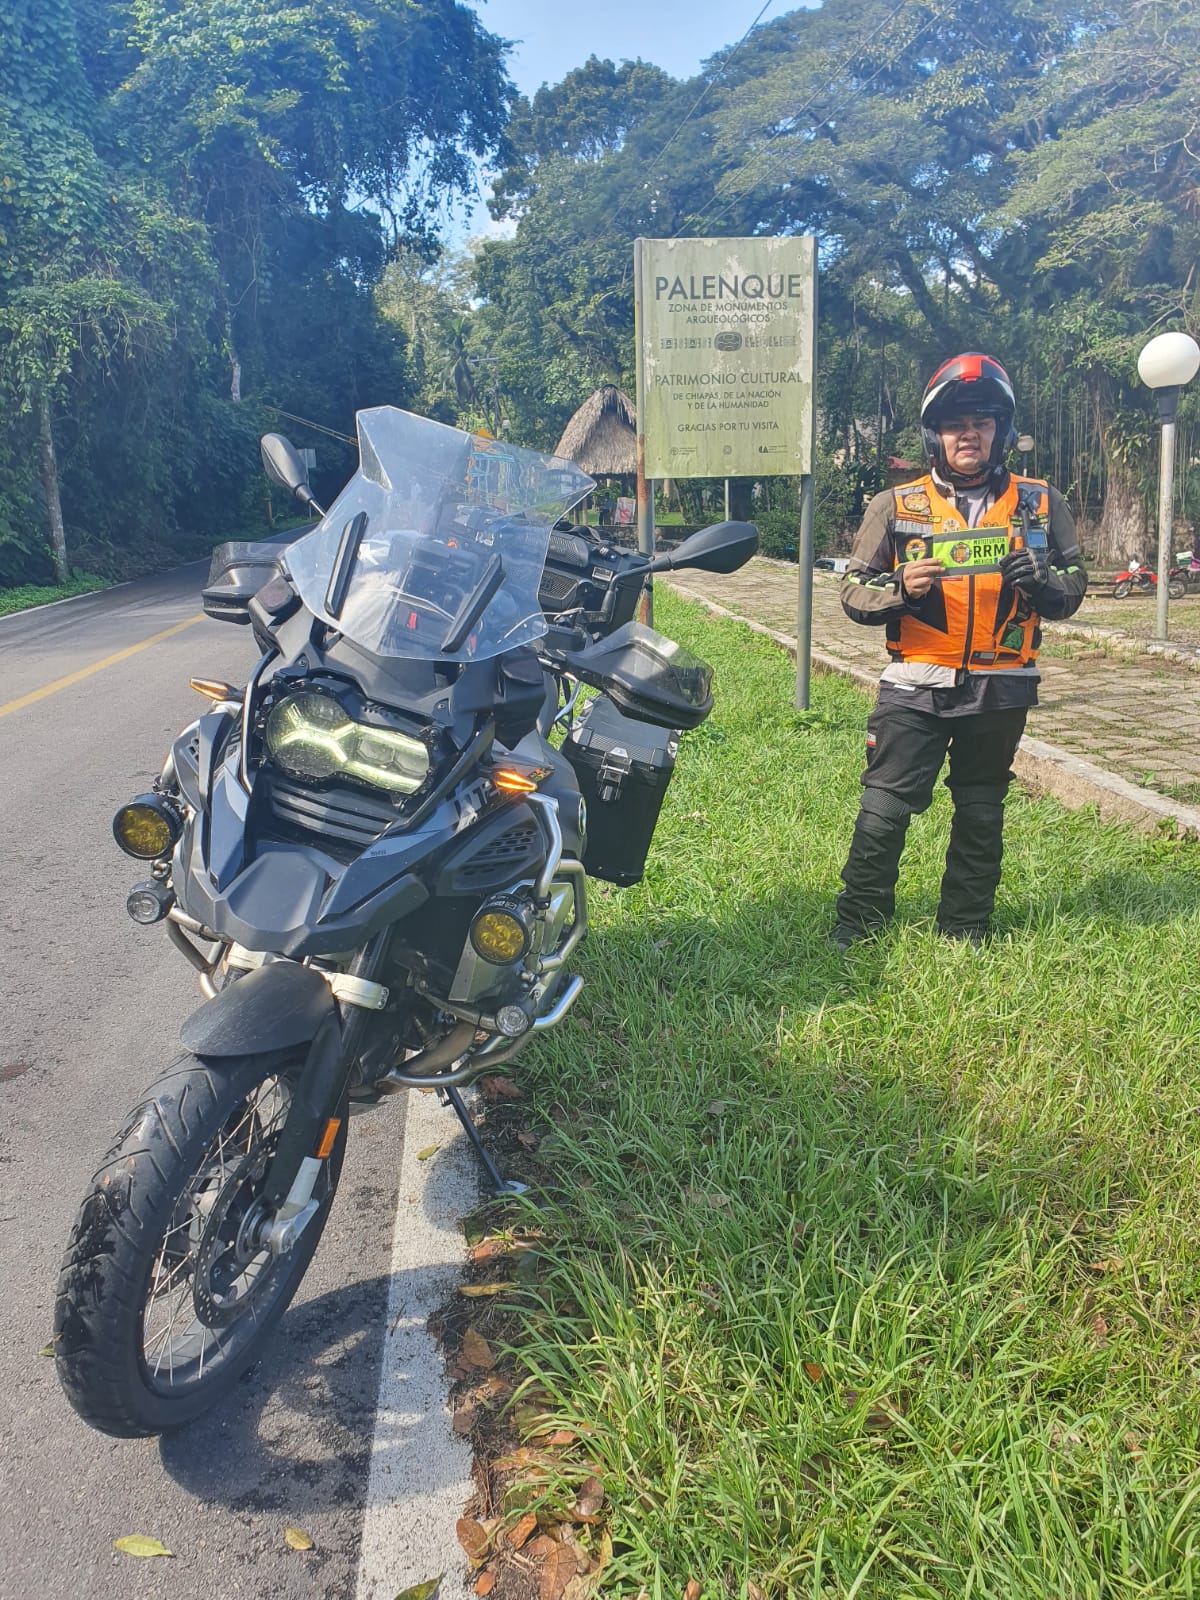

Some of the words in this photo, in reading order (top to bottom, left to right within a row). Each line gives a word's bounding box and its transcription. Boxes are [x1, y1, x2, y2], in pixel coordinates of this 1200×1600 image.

[655, 274, 801, 300] PALENQUE
[668, 303, 698, 313] ZONA
[700, 303, 713, 312] DE
[715, 301, 788, 312] MONUMENTOS
[686, 313, 771, 324] ARQUEOLÓGICOS
[655, 373, 737, 386] PATRIMONIO
[740, 371, 803, 384] CULTURAL
[673, 392, 684, 401] DE
[723, 391, 734, 399] DE
[736, 391, 746, 399] LA
[748, 390, 781, 398] NACIÓN
[687, 402, 692, 410] Y
[694, 402, 705, 410] DE
[719, 401, 769, 409] HUMANIDAD
[677, 423, 717, 432] GRACIAS
[719, 422, 737, 431] POR
[739, 422, 750, 431] TU
[752, 421, 779, 430] VISITA
[973, 543, 1005, 558] RRM
